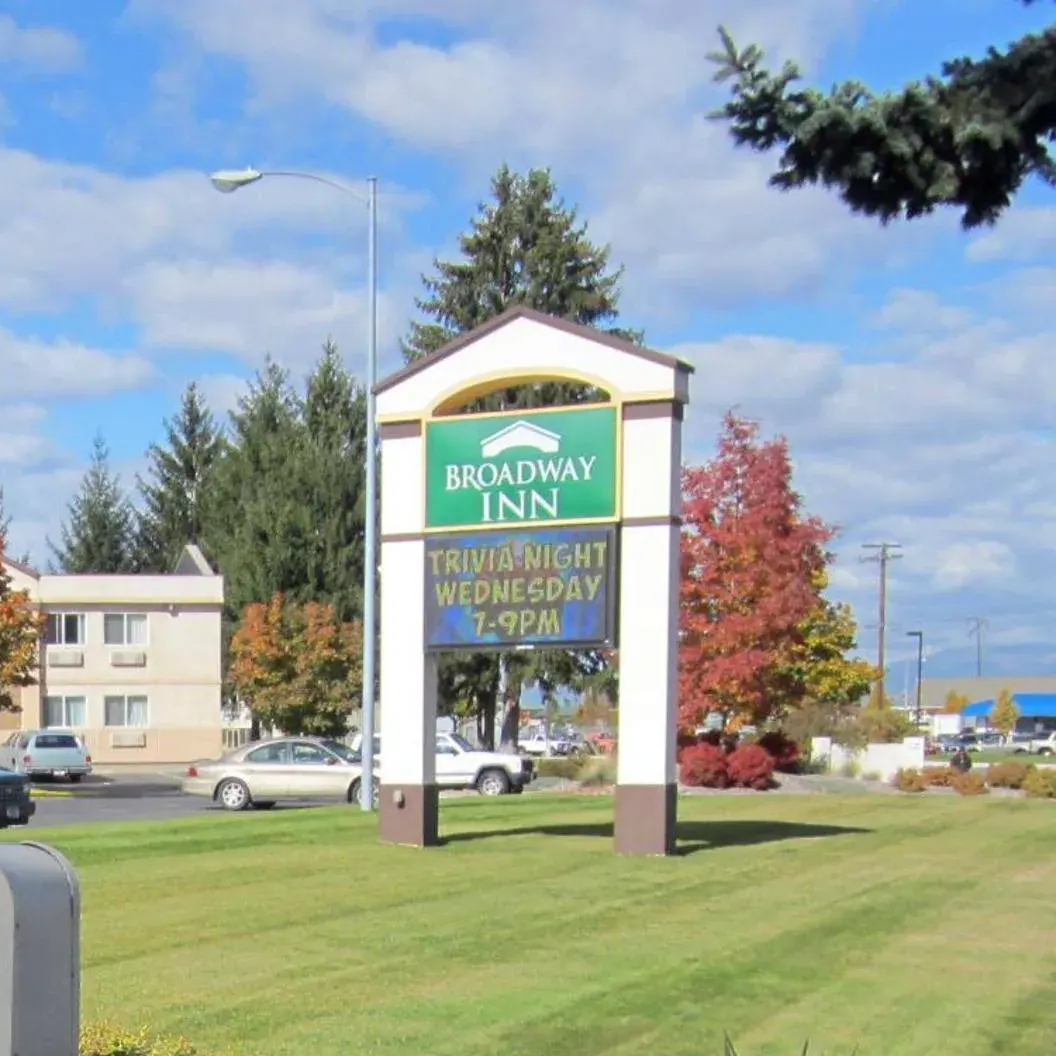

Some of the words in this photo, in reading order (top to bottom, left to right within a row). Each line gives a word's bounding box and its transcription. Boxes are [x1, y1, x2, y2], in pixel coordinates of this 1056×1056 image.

[445, 456, 596, 491] BROADWAY
[480, 488, 559, 522] INN
[429, 548, 514, 574] TRIVIA
[525, 543, 607, 570] NIGHT
[436, 575, 601, 605] WEDNESDAY
